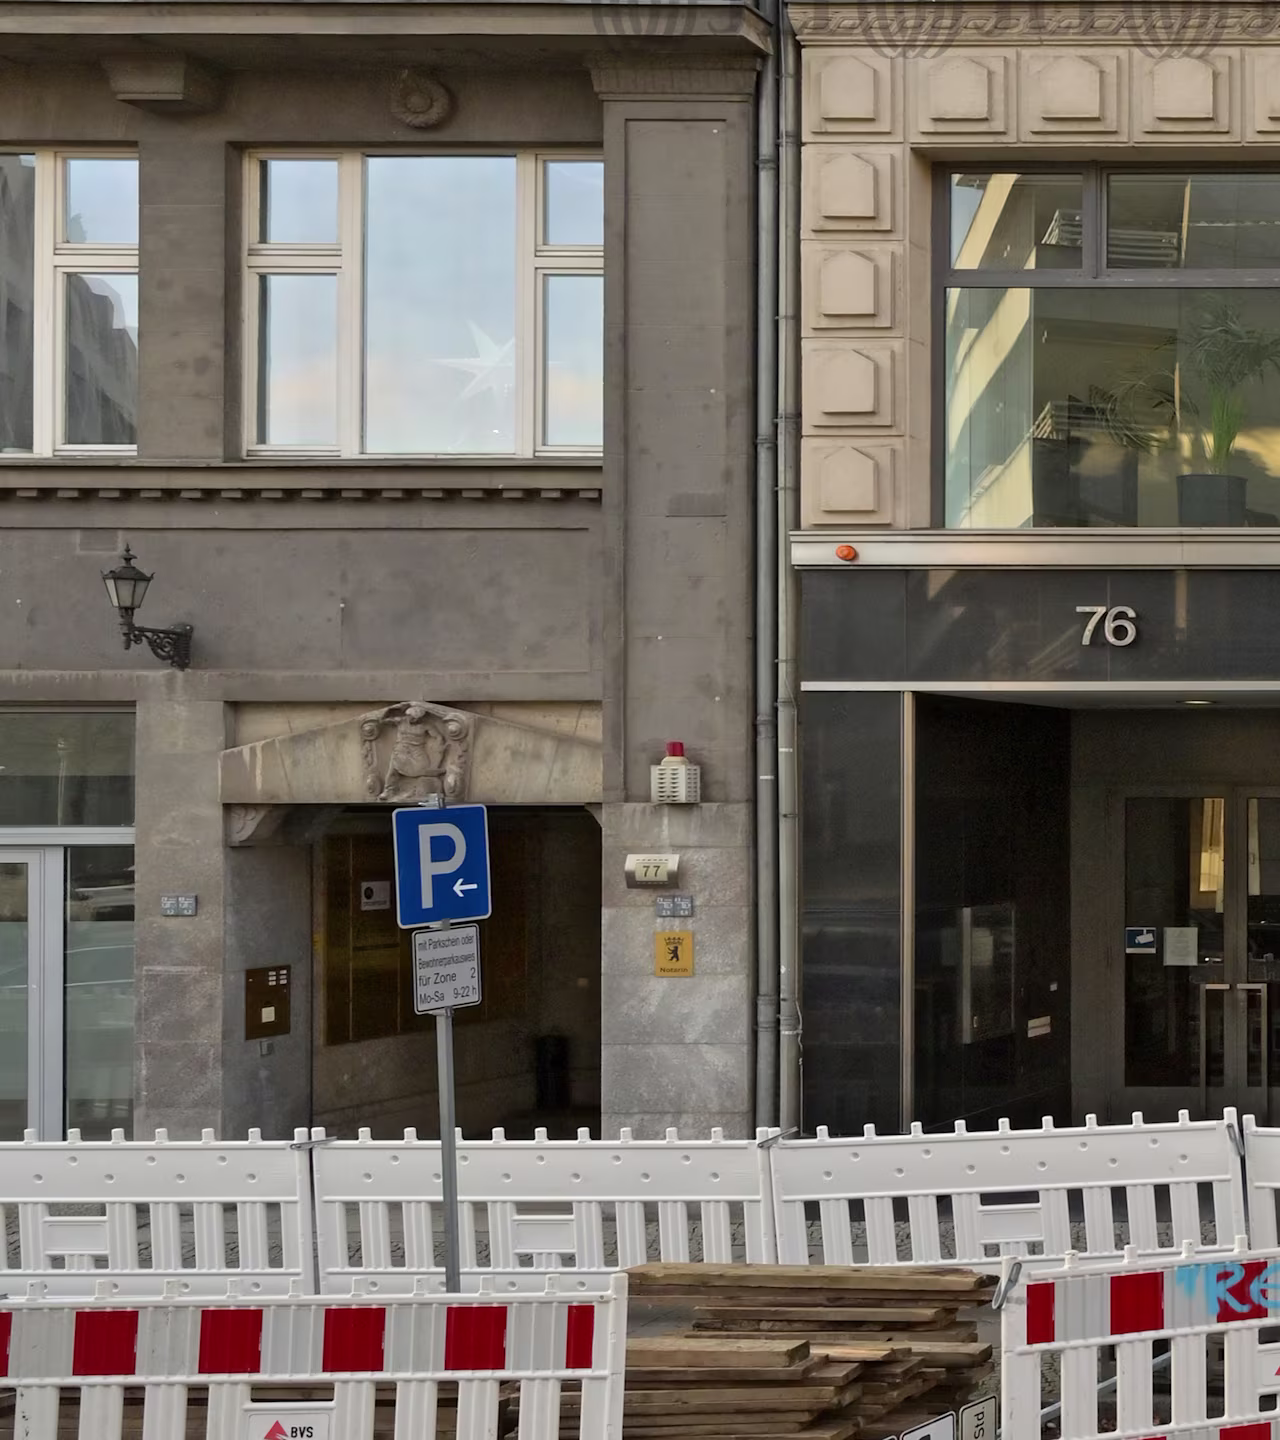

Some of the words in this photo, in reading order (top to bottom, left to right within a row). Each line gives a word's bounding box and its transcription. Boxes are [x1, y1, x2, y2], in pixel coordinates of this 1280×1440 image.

[1076, 606, 1136, 646] 76
[418, 823, 467, 909] P
[642, 865, 660, 878] 77
[418, 940, 427, 951] mit
[428, 936, 460, 950] Parkschein
[461, 933, 474, 945] oder
[419, 975, 431, 987] für
[434, 972, 457, 985] Zone
[470, 967, 476, 979] 2
[420, 990, 445, 1005] Mo-Sa
[453, 985, 470, 999] 9-22
[471, 985, 477, 996] h
[290, 1426, 314, 1439] BVS
[973, 1406, 985, 1439] Std.
